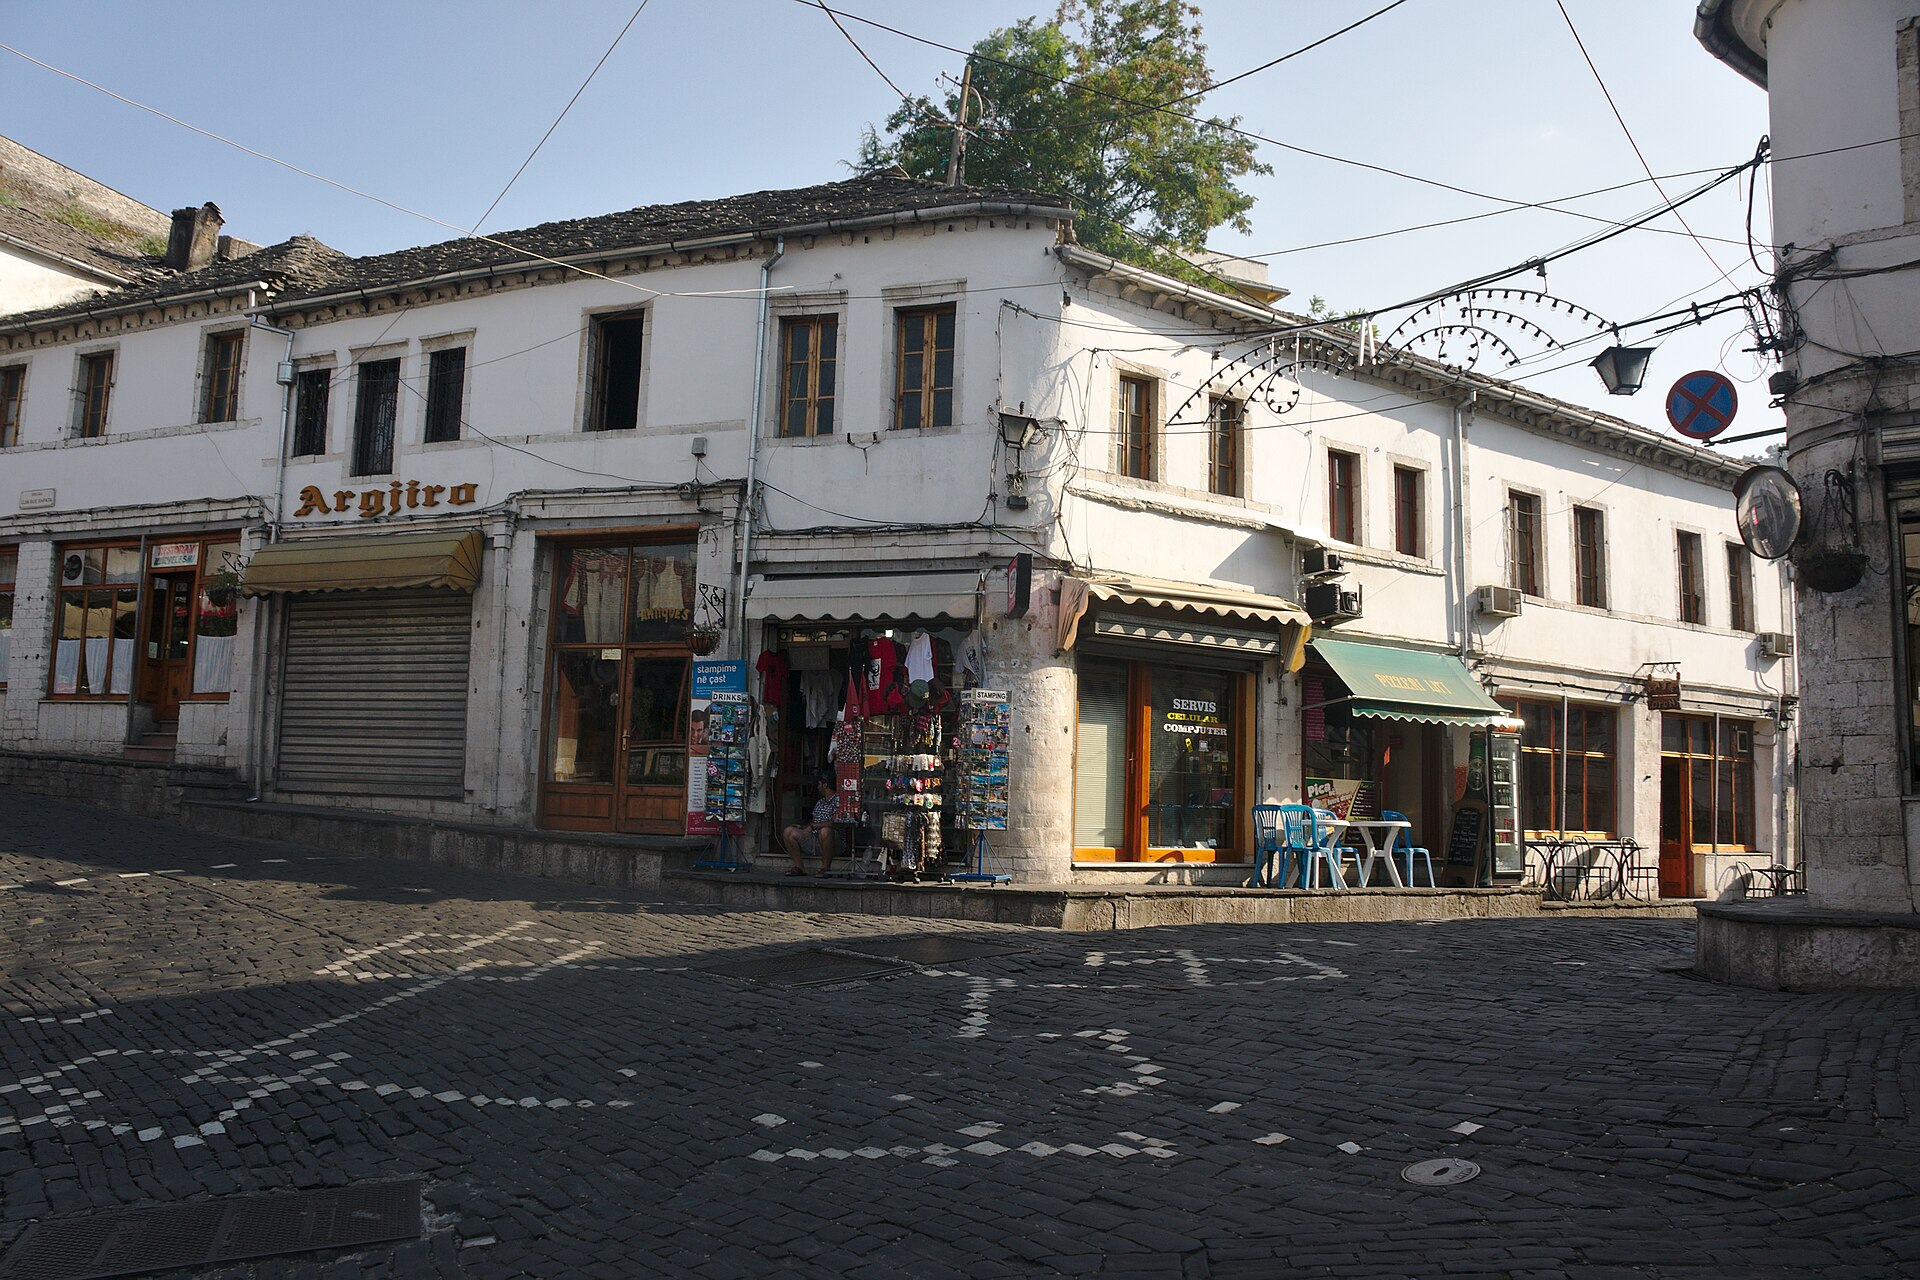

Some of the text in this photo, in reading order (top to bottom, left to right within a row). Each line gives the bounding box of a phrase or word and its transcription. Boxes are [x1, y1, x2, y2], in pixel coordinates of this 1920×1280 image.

[295, 480, 479, 518] Argjiro
[638, 607, 689, 623] ANTIQUES
[697, 664, 737, 674] stampime
[697, 674, 726, 685] në çast
[713, 693, 742, 701] DRINKS
[976, 691, 1006, 700] STAMPING
[1173, 698, 1217, 713] SERVIS
[1167, 712, 1218, 723] CELULAR
[1163, 723, 1228, 736] COMPJUTER
